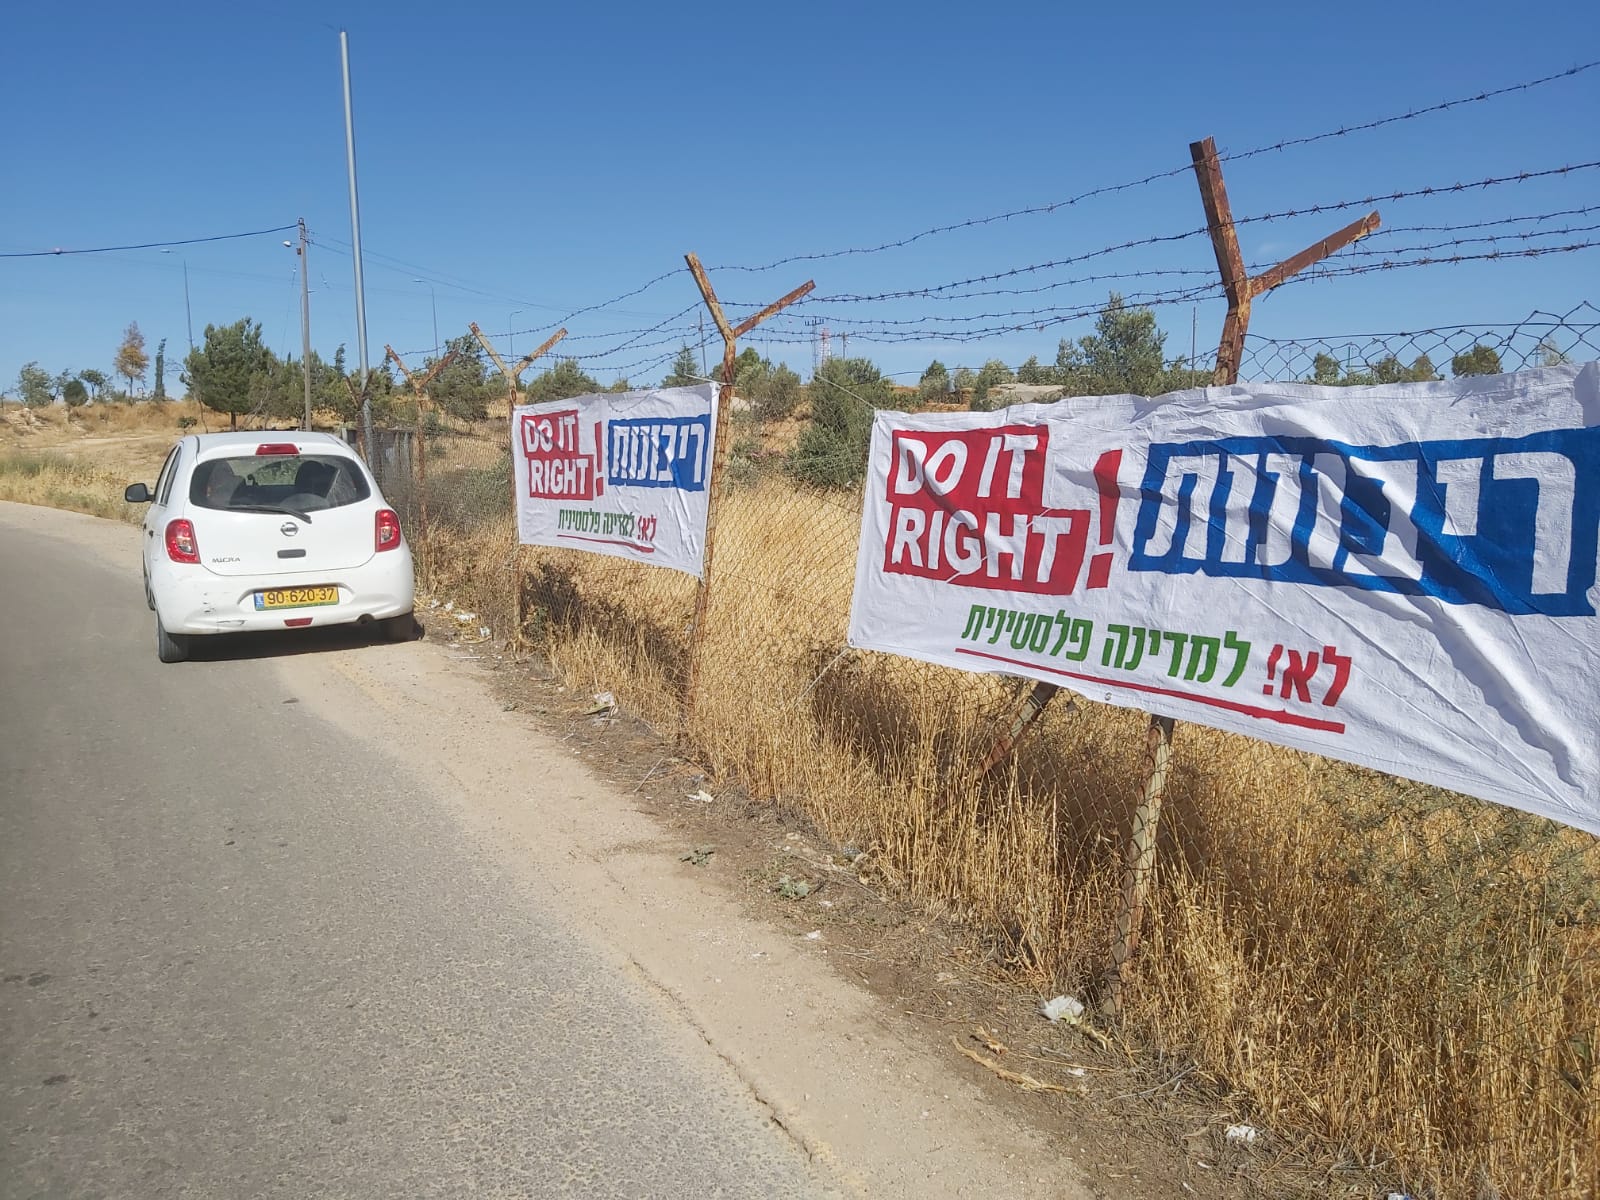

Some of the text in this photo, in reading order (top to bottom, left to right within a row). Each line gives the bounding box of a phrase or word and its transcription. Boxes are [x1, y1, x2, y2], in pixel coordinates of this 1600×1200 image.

[524, 414, 576, 453] DO IT
[611, 423, 706, 484] ריבונות
[894, 433, 1039, 499] DO IT
[1144, 450, 1576, 596] ריבונות
[961, 604, 1352, 706] לא! למדינה פלסטינית
